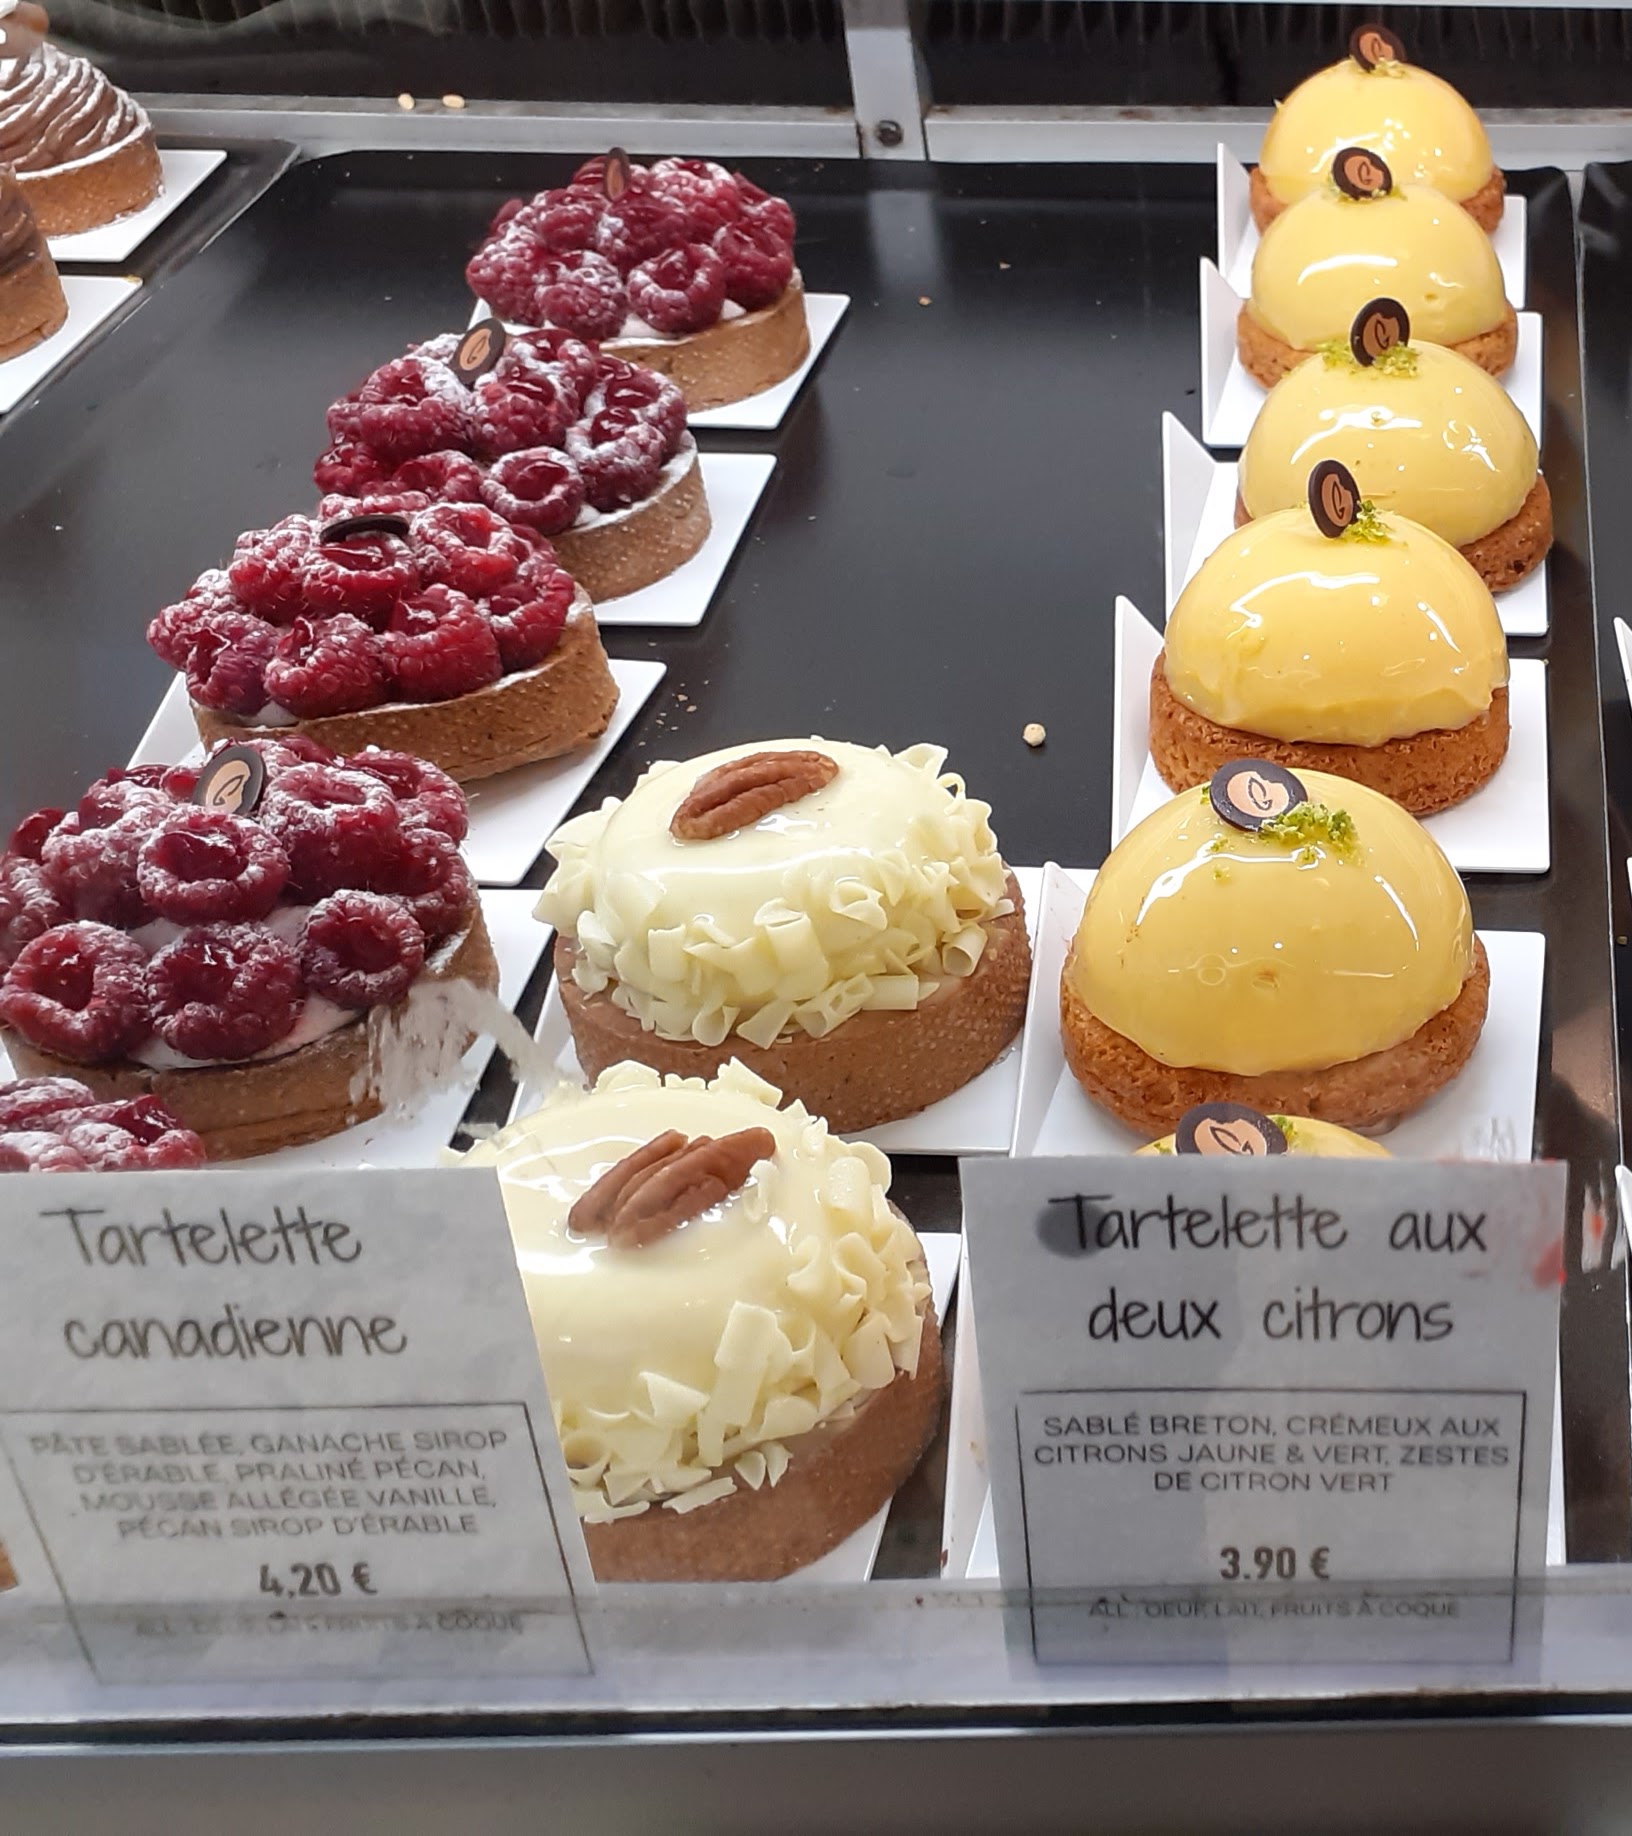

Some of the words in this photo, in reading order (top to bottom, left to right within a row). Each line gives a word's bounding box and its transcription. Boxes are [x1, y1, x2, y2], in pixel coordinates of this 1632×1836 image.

[39, 1206, 363, 1268] Tartelette
[1047, 1193, 1349, 1252] Tartelette
[1388, 1209, 1489, 1254] aux
[1087, 1286, 1223, 1342] deux
[1262, 1288, 1454, 1343] citrons
[63, 1303, 409, 1361] canadienne
[1043, 1411, 1141, 1437] SABLÉ
[1149, 1414, 1277, 1437] BRETON,
[1286, 1411, 1432, 1437] CRÉMEUX
[1440, 1414, 1500, 1437] AUX
[250, 1431, 405, 1455] GANACHE
[412, 1429, 507, 1451] SIROP
[1033, 1443, 1168, 1467] CITRONS
[1177, 1443, 1276, 1465] JAUNE
[1285, 1443, 1304, 1465] &
[1311, 1444, 1390, 1467] VERT,
[1399, 1444, 1509, 1466] ZESTES
[234, 1457, 366, 1482] PRALINÉ
[374, 1454, 486, 1481] PÉCAN,
[1153, 1471, 1192, 1493] DE
[1200, 1471, 1310, 1493] CITRON
[1319, 1471, 1394, 1493] VERT
[226, 1485, 362, 1511] ALLÉGÉE
[366, 1485, 497, 1508] VANILLE,
[117, 1515, 223, 1539] PÉCAN
[230, 1517, 324, 1538] SIROP
[333, 1512, 479, 1536] D'ÉRABLE
[1219, 1545, 1297, 1580] 3.90
[1309, 1544, 1331, 1581] €
[351, 1560, 379, 1596] €
